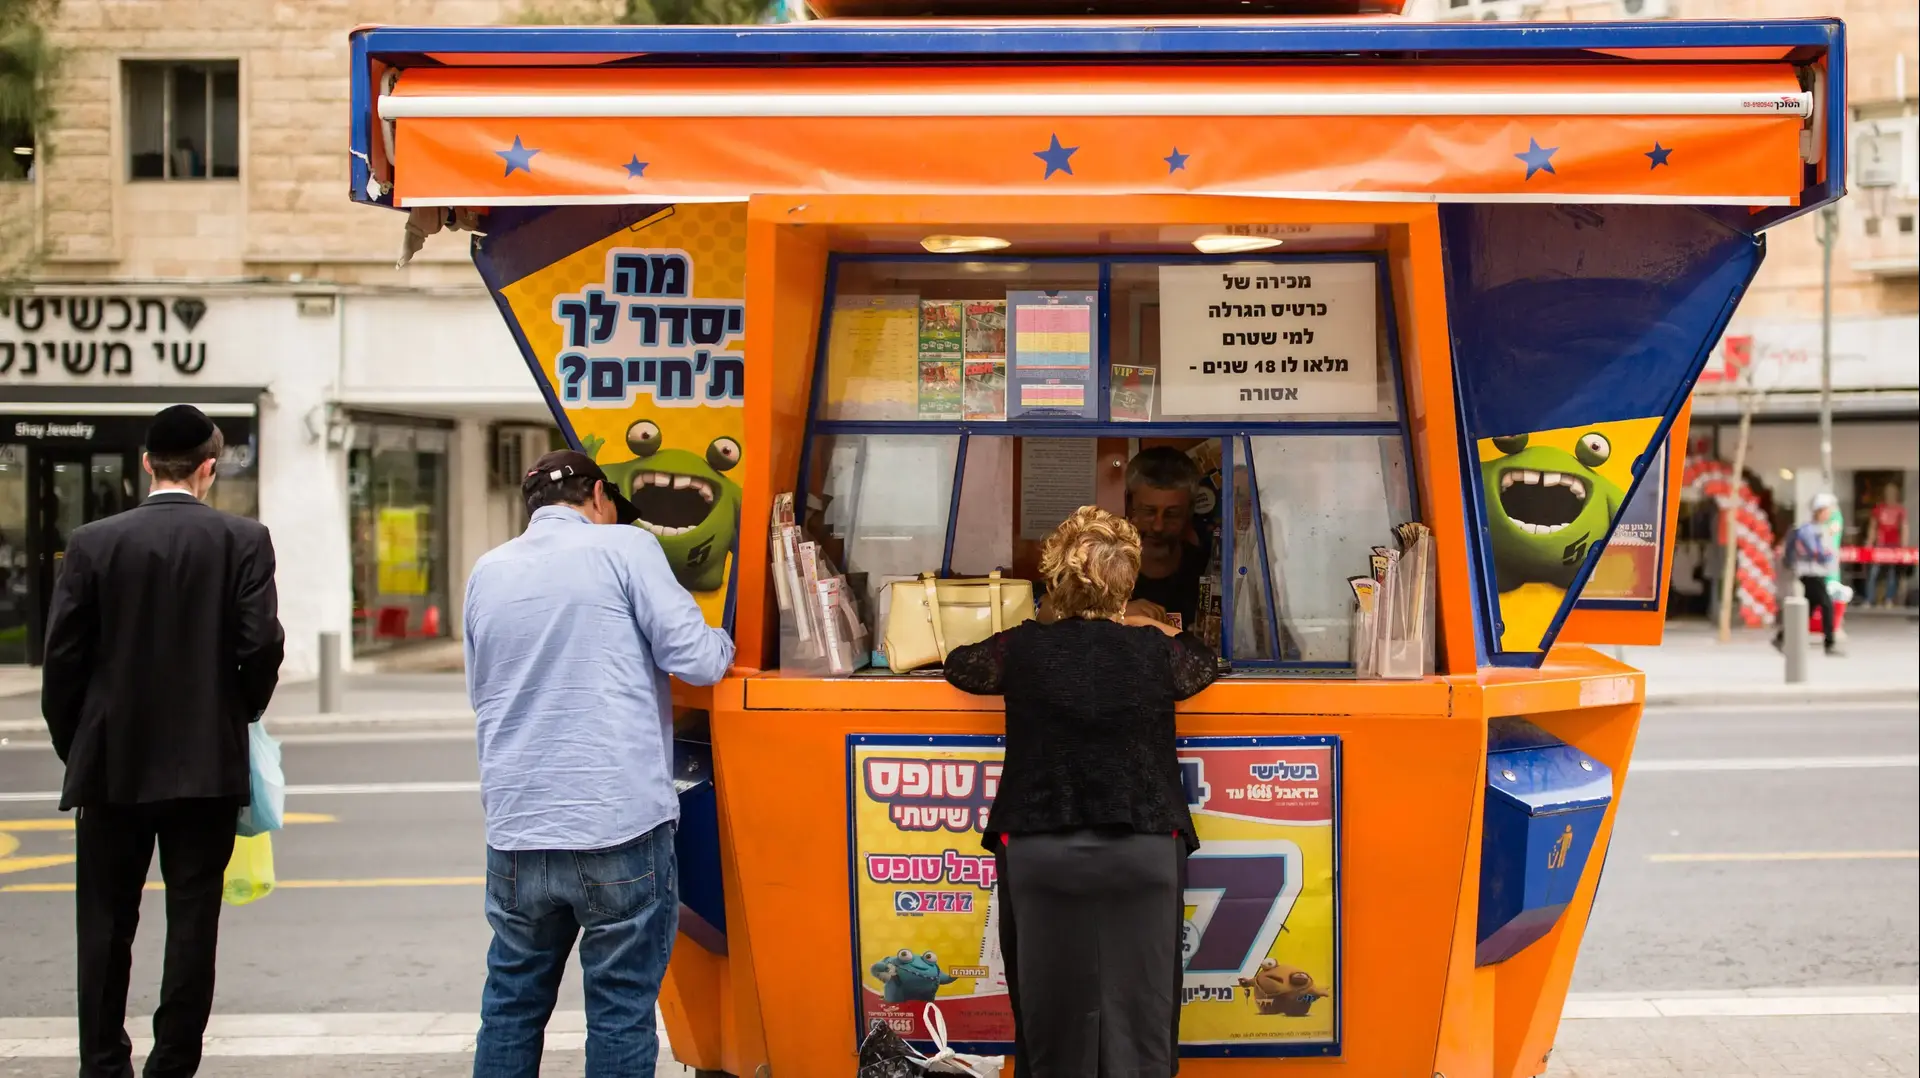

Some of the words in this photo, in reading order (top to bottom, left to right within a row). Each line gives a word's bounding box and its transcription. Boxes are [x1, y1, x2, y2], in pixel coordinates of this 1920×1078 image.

[614, 254, 688, 296] מה
[1222, 273, 1251, 290] של
[1255, 274, 1312, 290] מכירה
[1208, 301, 1266, 319] הגרלה
[1271, 303, 1327, 317] כרטיס
[559, 291, 619, 348] לך
[629, 304, 744, 346] יסדר
[1222, 328, 1276, 345] שטרם
[1282, 328, 1314, 344] למי
[152, 342, 206, 375] שי
[1203, 358, 1248, 374] שנים
[1254, 357, 1276, 373] 18
[1281, 356, 1299, 373] לו
[1303, 356, 1349, 372] מלאו
[1113, 366, 1133, 376] VIP
[1239, 385, 1299, 403] אסורה
[15, 422, 44, 439] Shay
[46, 422, 95, 439] Jewelry
[1250, 761, 1318, 780] בשלישי
[868, 760, 977, 799] טופס
[1225, 788, 1244, 799] עד
[1274, 785, 1319, 799] בדאבל
[893, 806, 970, 829] שיטתי
[868, 856, 943, 881] טופס
[945, 850, 997, 888] קבל
[924, 893, 973, 911] 777
[1181, 984, 1233, 1005] מיליון
